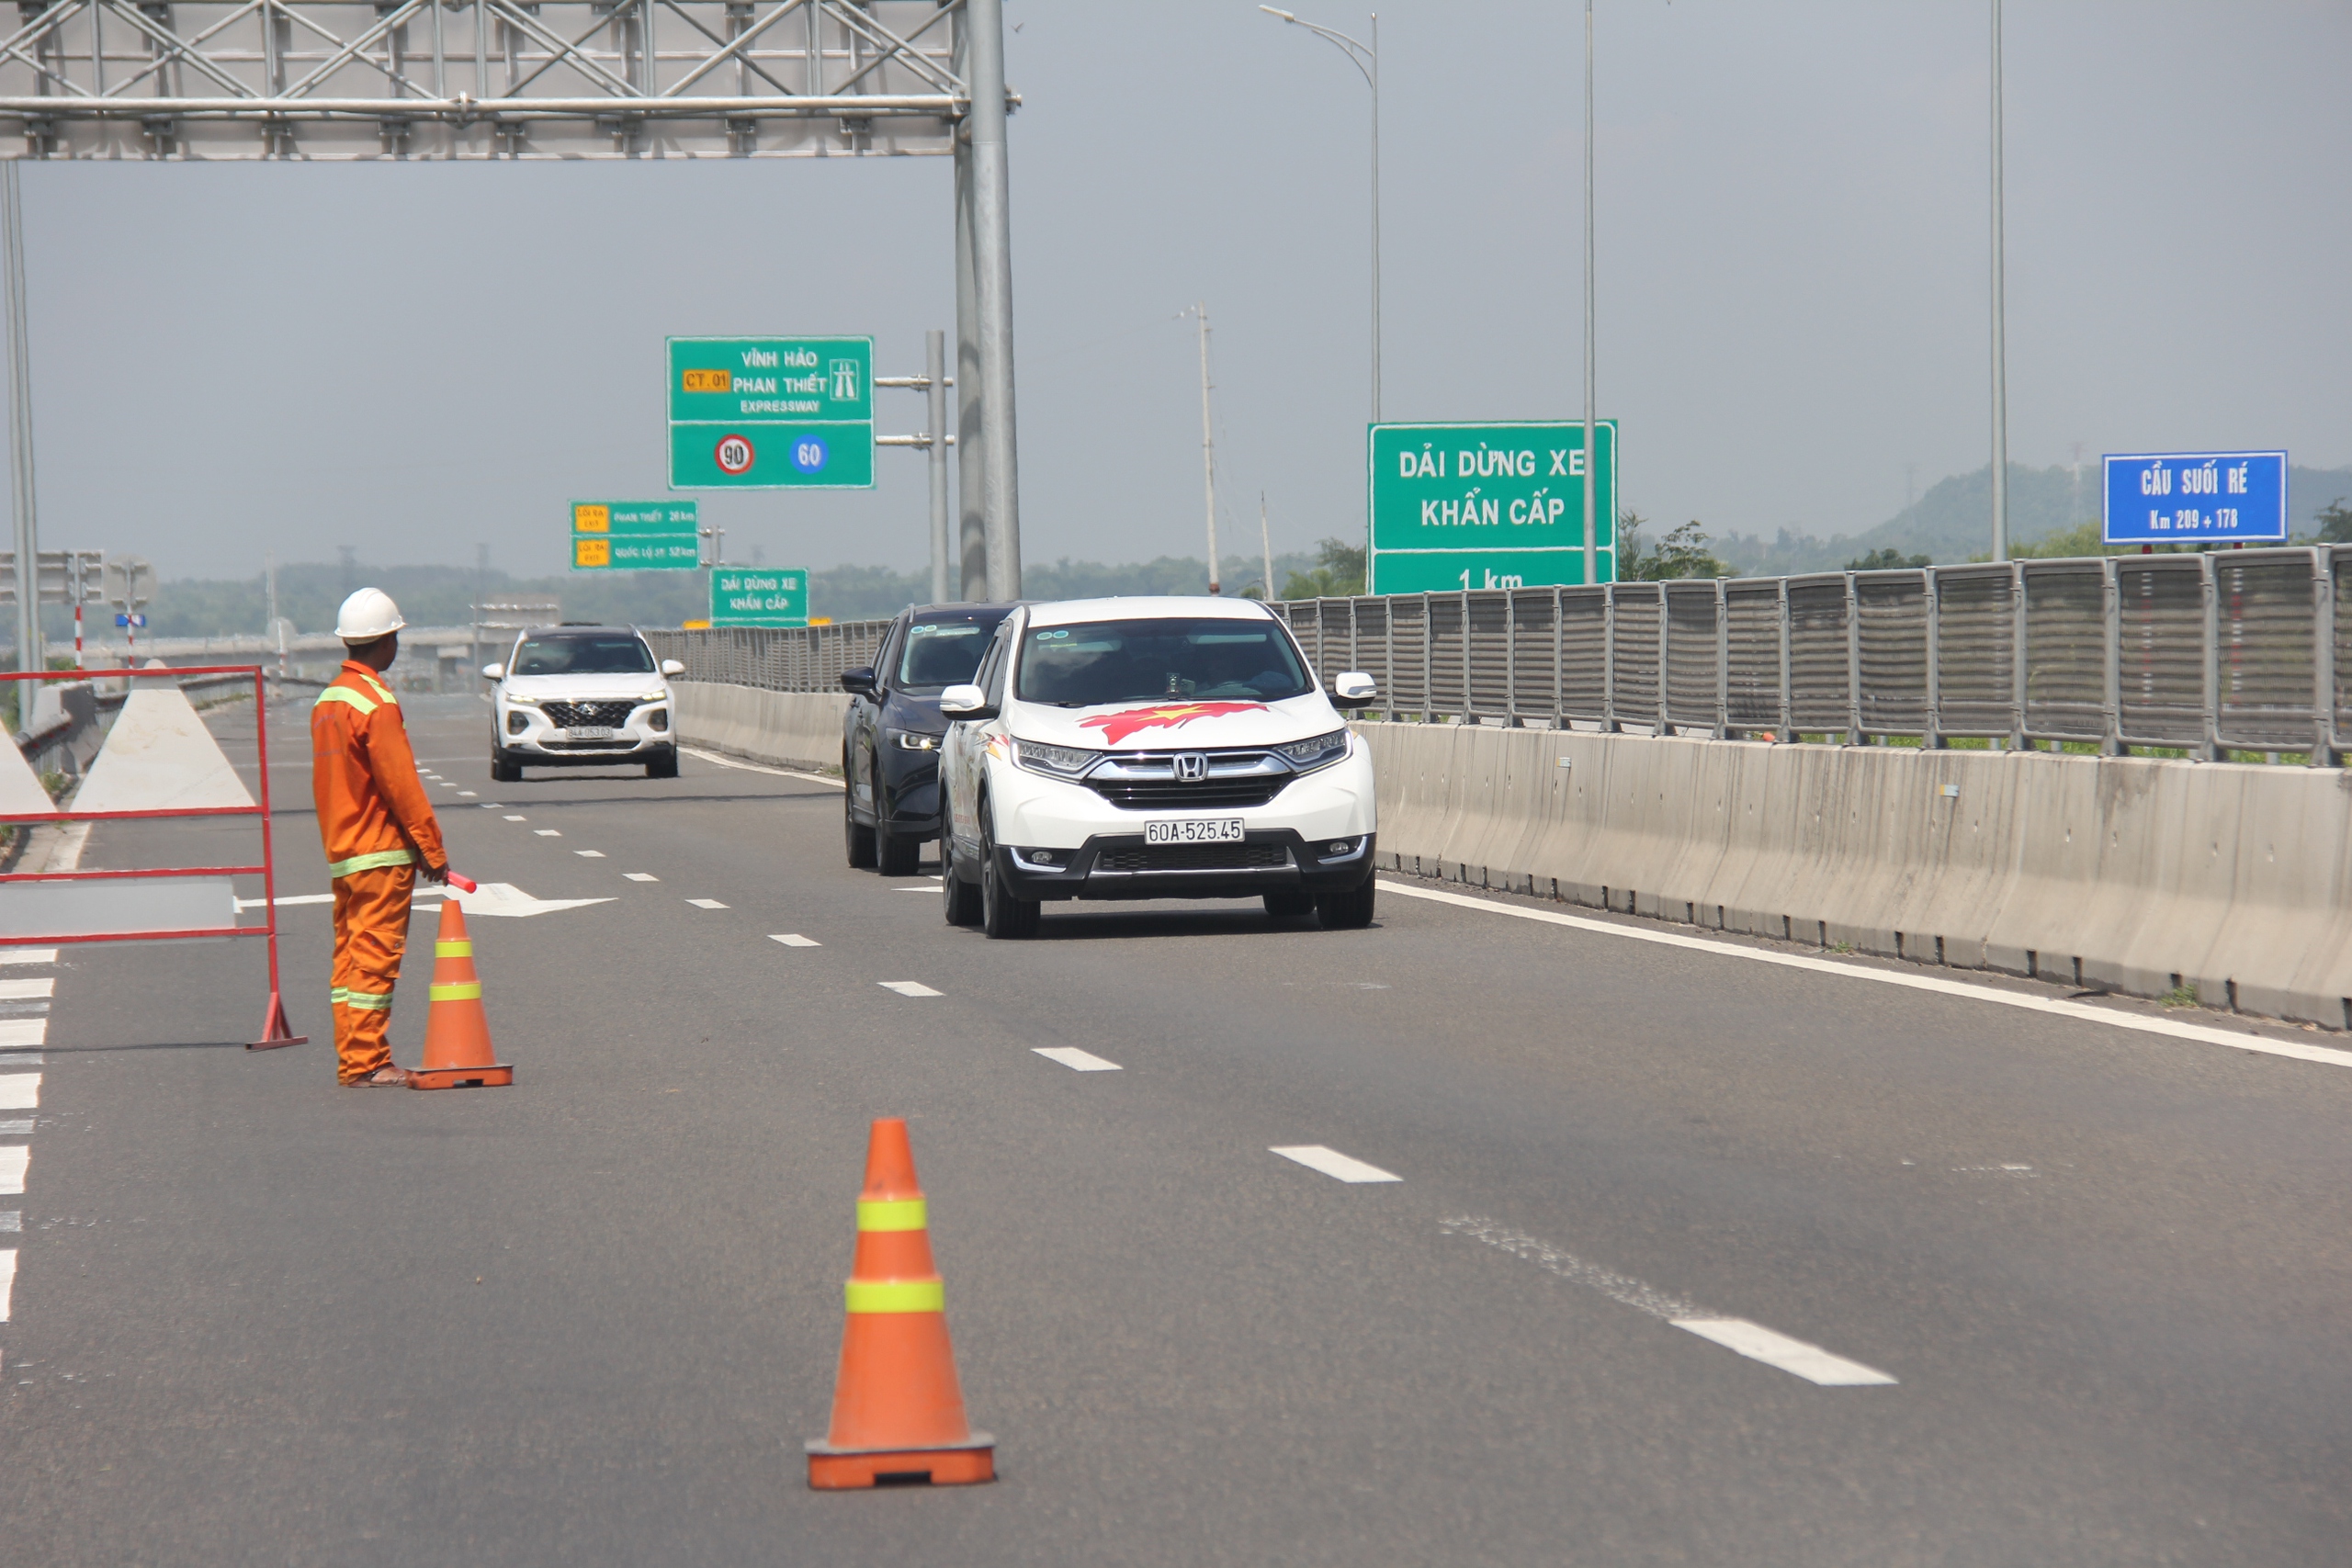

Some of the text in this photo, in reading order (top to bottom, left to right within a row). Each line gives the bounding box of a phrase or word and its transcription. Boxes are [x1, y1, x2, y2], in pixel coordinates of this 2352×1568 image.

[741, 347, 818, 367] VĨNH HẢO
[733, 371, 827, 393] PHAN THIẾT
[741, 400, 820, 412] EXPRESSWAY
[725, 445, 744, 465] 90
[797, 443, 821, 466] 60
[1399, 442, 1585, 478] DẢI DỪNG XE
[2141, 459, 2248, 495] CẦU SUỐI RÉ
[1421, 487, 1565, 525] KHẨN CẤP
[2150, 509, 2239, 529] Km 209 + 178
[781, 578, 797, 590] XE
[1458, 568, 1522, 591] 1 km
[1148, 820, 1240, 841] 60A-525.45
